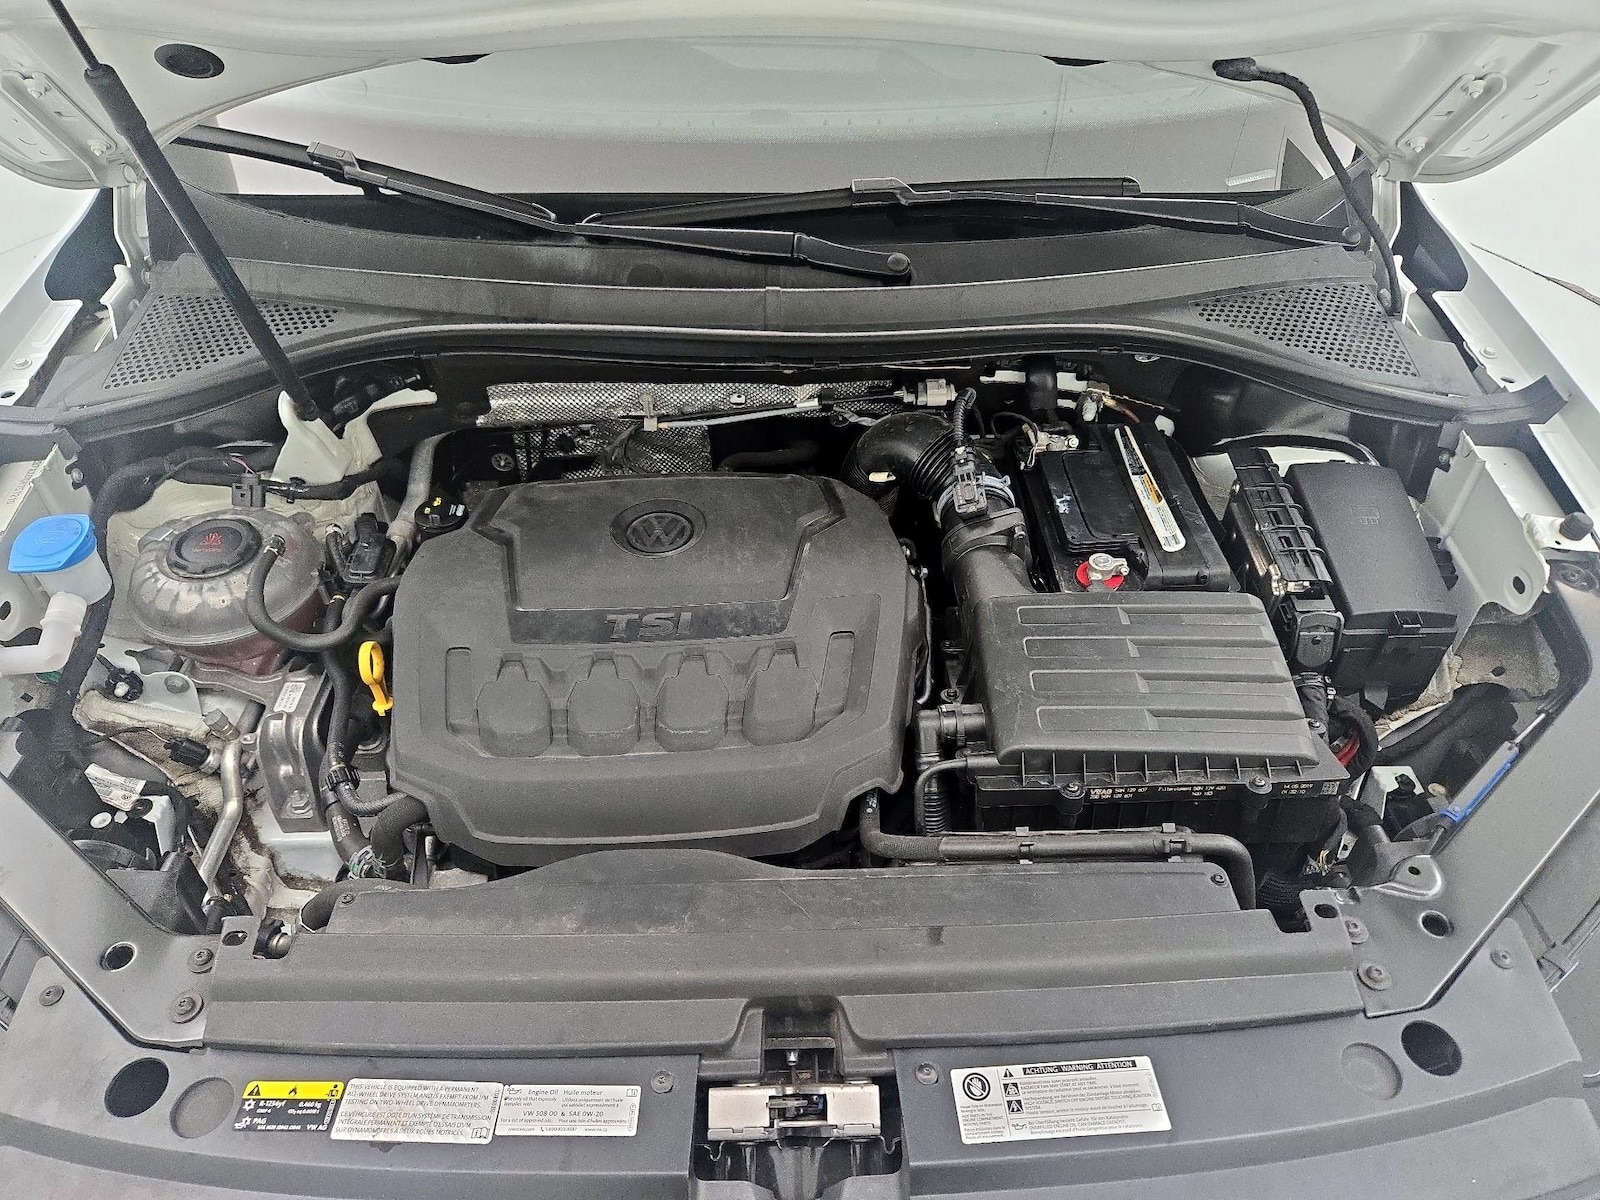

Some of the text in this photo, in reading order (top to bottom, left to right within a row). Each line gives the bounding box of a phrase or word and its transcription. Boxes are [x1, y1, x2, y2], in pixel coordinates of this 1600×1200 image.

[604, 611, 693, 640] TSI
[1025, 1060, 1132, 1074] ACHTUNG WARNING ATTENTION
